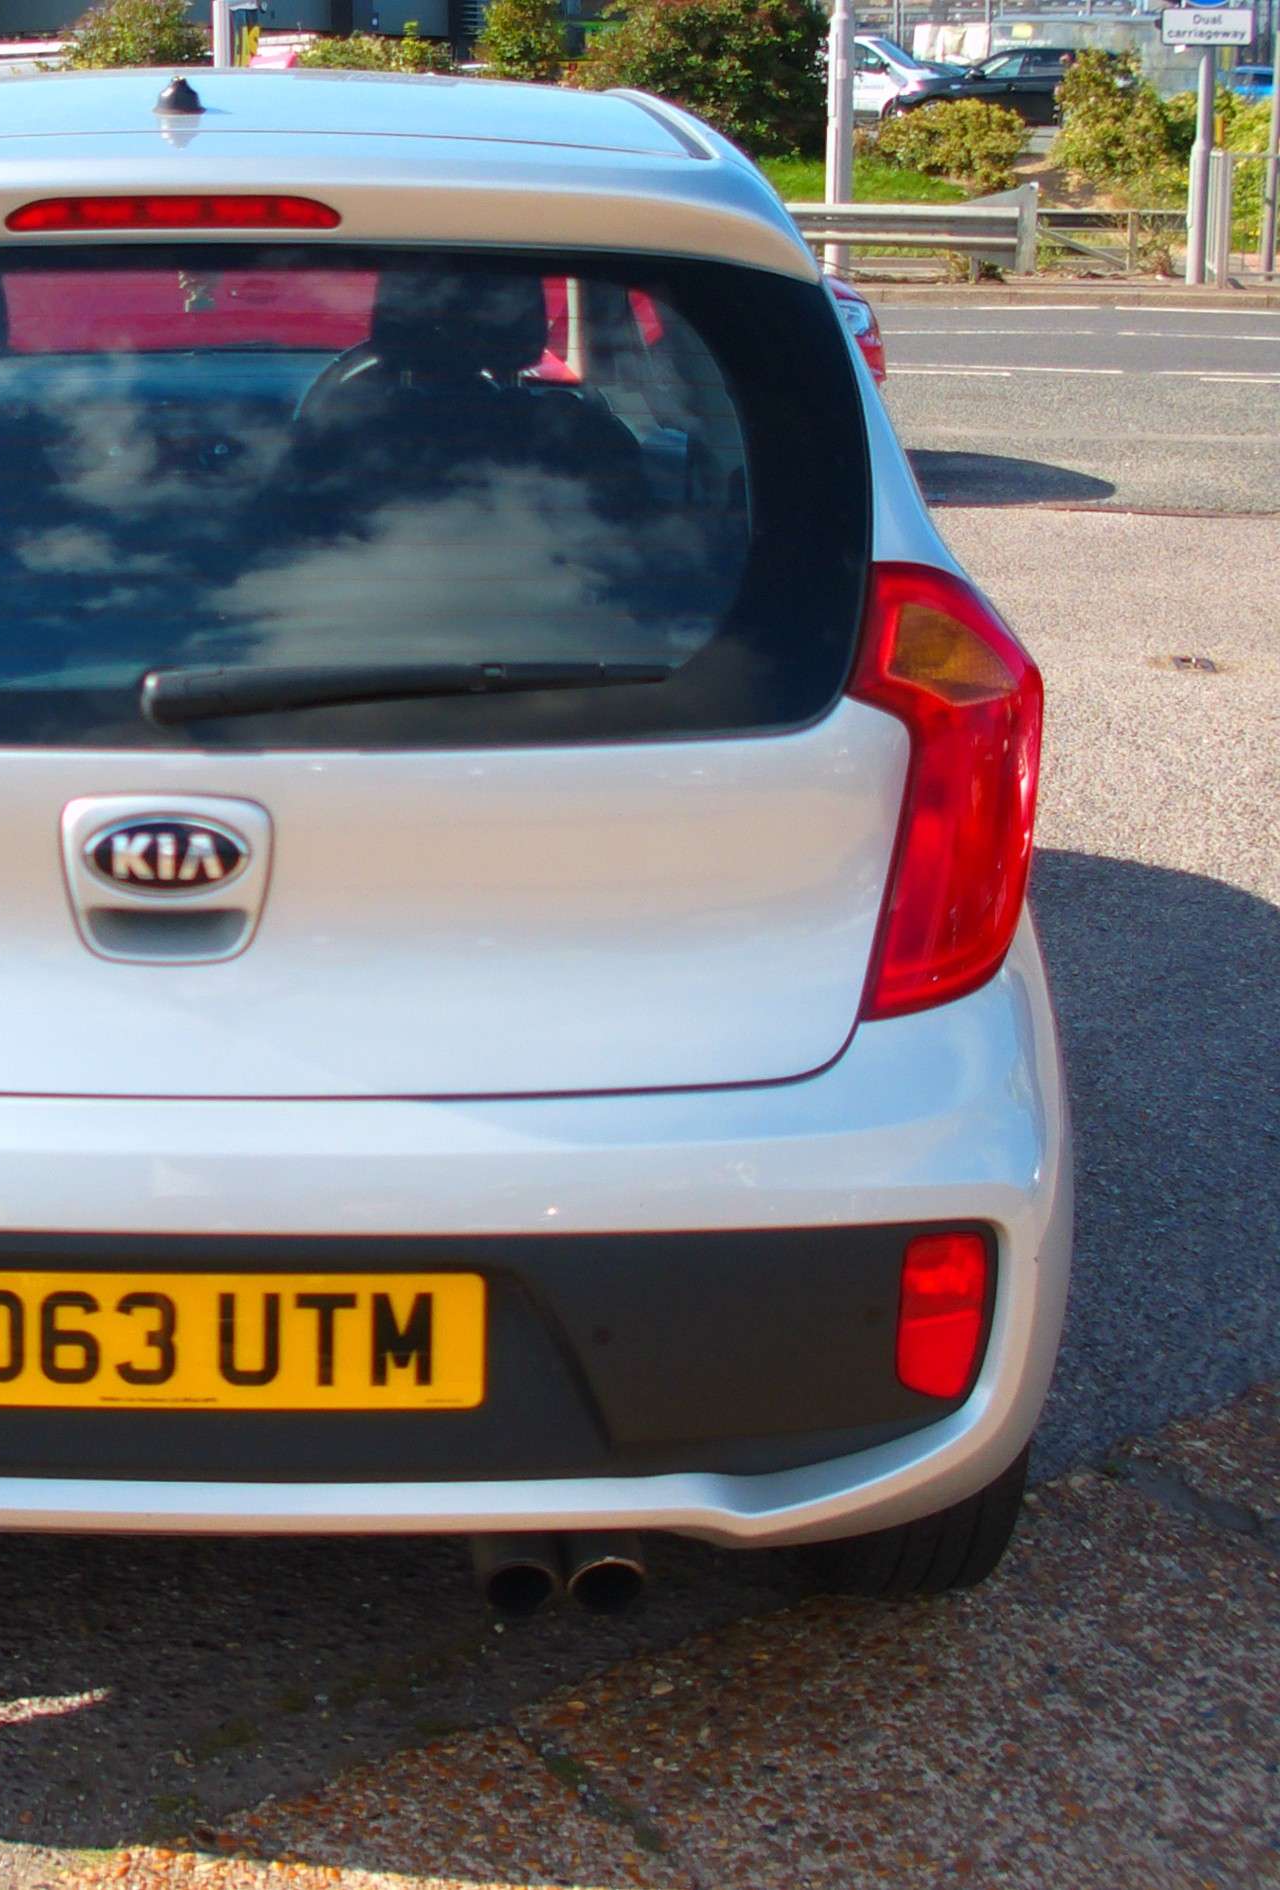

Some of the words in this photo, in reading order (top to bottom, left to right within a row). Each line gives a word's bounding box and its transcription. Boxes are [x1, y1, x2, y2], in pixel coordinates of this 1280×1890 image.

[1167, 29, 1246, 40] carriageway
[1192, 14, 1223, 25] Dual
[111, 832, 223, 881] KIA
[216, 1291, 434, 1387] UTM
